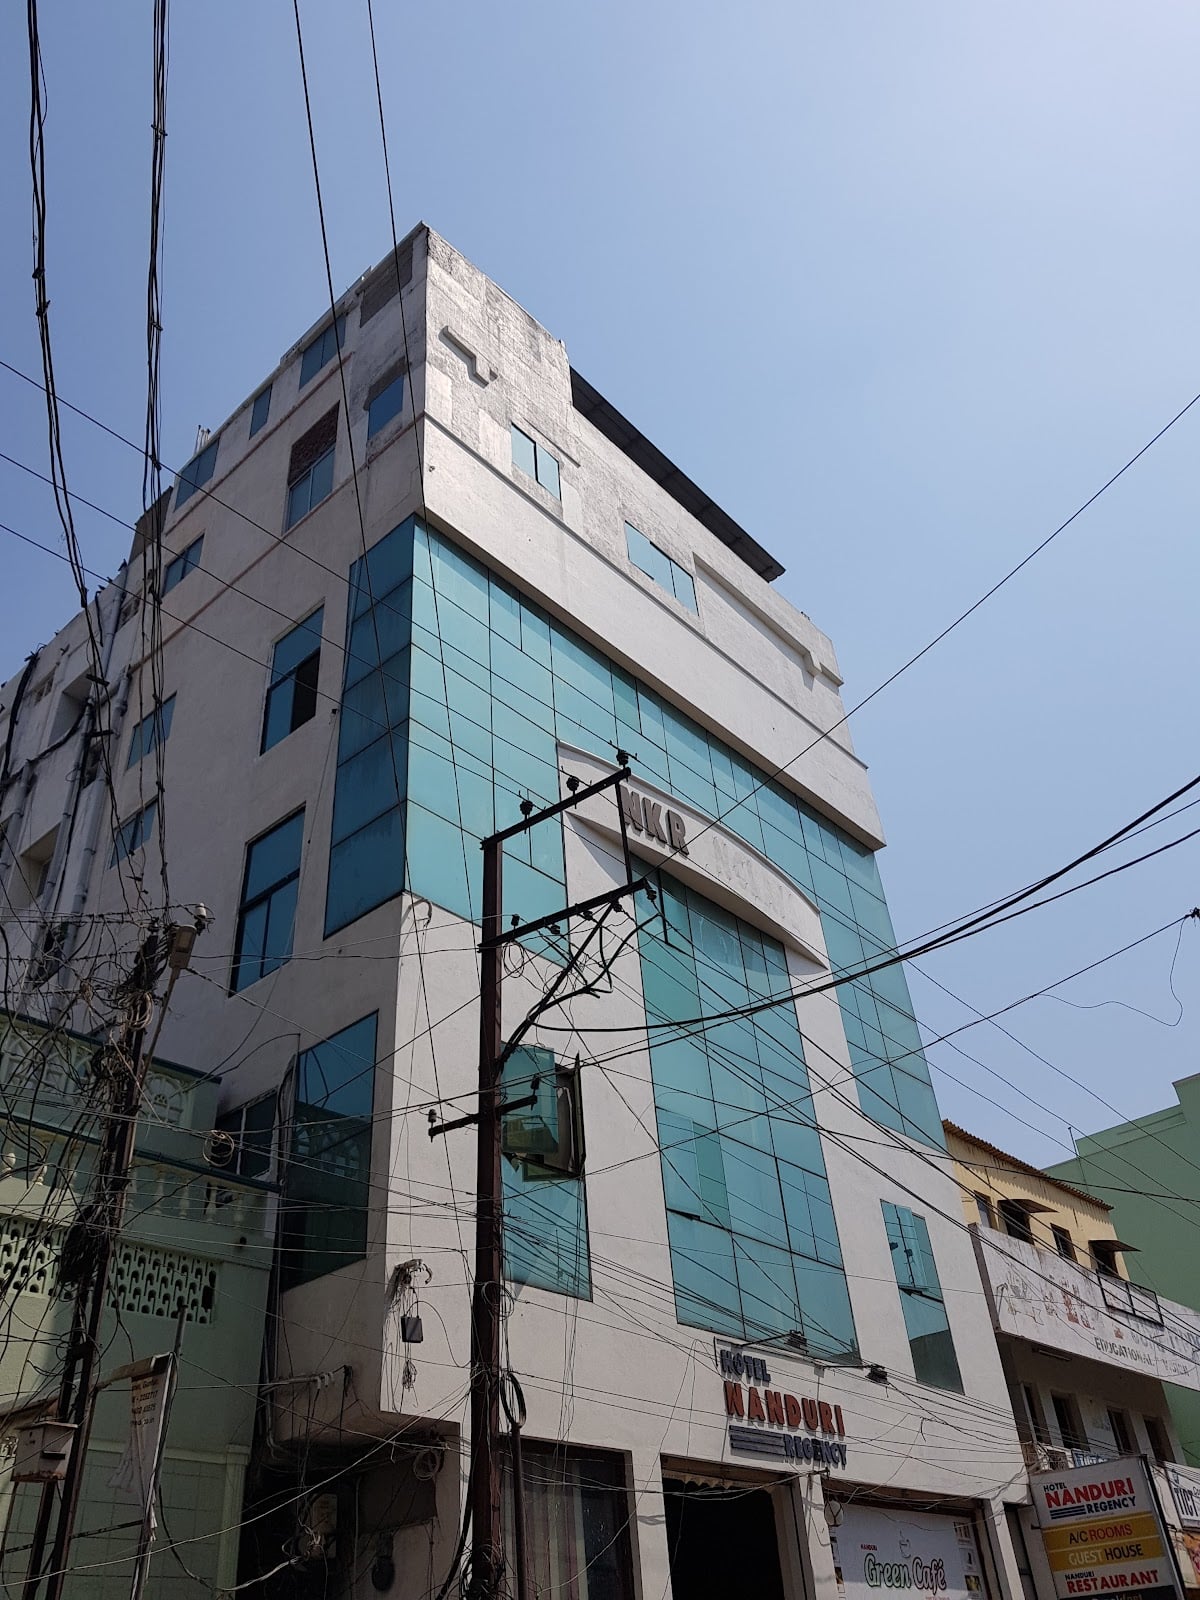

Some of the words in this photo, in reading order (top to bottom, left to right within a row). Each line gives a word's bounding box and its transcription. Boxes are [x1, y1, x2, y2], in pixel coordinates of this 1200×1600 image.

[621, 787, 689, 856] NKR
[720, 1349, 771, 1382] HOTEL
[723, 1380, 845, 1436] NANDURI
[783, 1433, 847, 1466] REGENCY
[1043, 1482, 1067, 1492] HOTEL
[1044, 1478, 1135, 1509] NANDURI
[1086, 1496, 1136, 1514] REGENCY
[1069, 1530, 1088, 1544] A/C
[1088, 1524, 1133, 1541] ROOMS
[1068, 1550, 1103, 1566] GUEST
[1104, 1544, 1144, 1560] HOUSE
[864, 1553, 911, 1588] Green
[912, 1556, 946, 1596] Café
[1065, 1571, 1094, 1580] NANDURI
[1066, 1569, 1159, 1594] RESTAURANT
